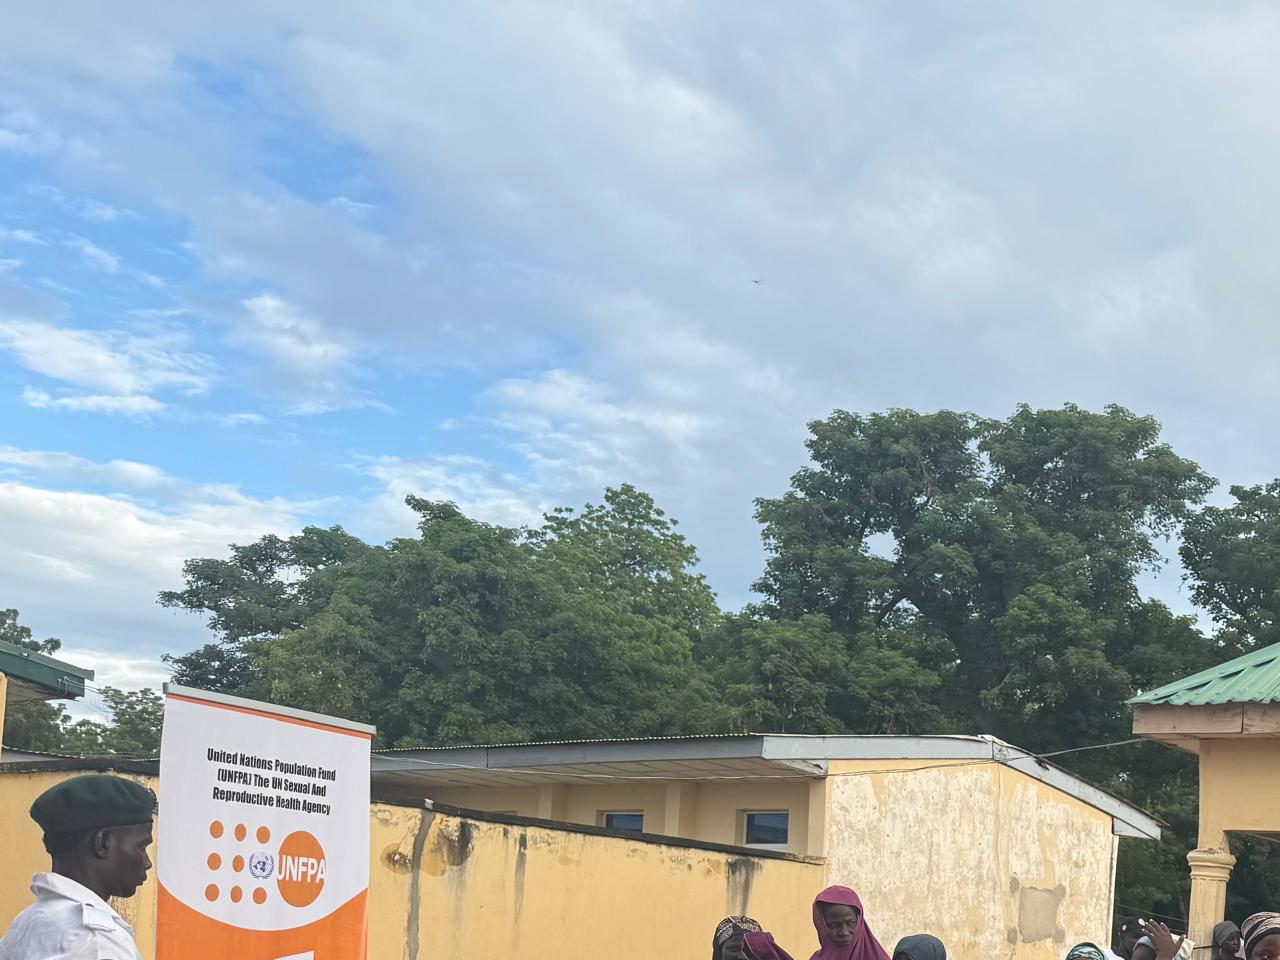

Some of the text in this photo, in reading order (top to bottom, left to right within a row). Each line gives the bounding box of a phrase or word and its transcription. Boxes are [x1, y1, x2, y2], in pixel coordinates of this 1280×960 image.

[207, 748, 336, 781] United Nations Population Fund
[217, 768, 327, 797] (UNFPA) The UN Sexual And
[212, 787, 331, 816] Reproductive Health Agency
[275, 854, 327, 884] UNFPA
